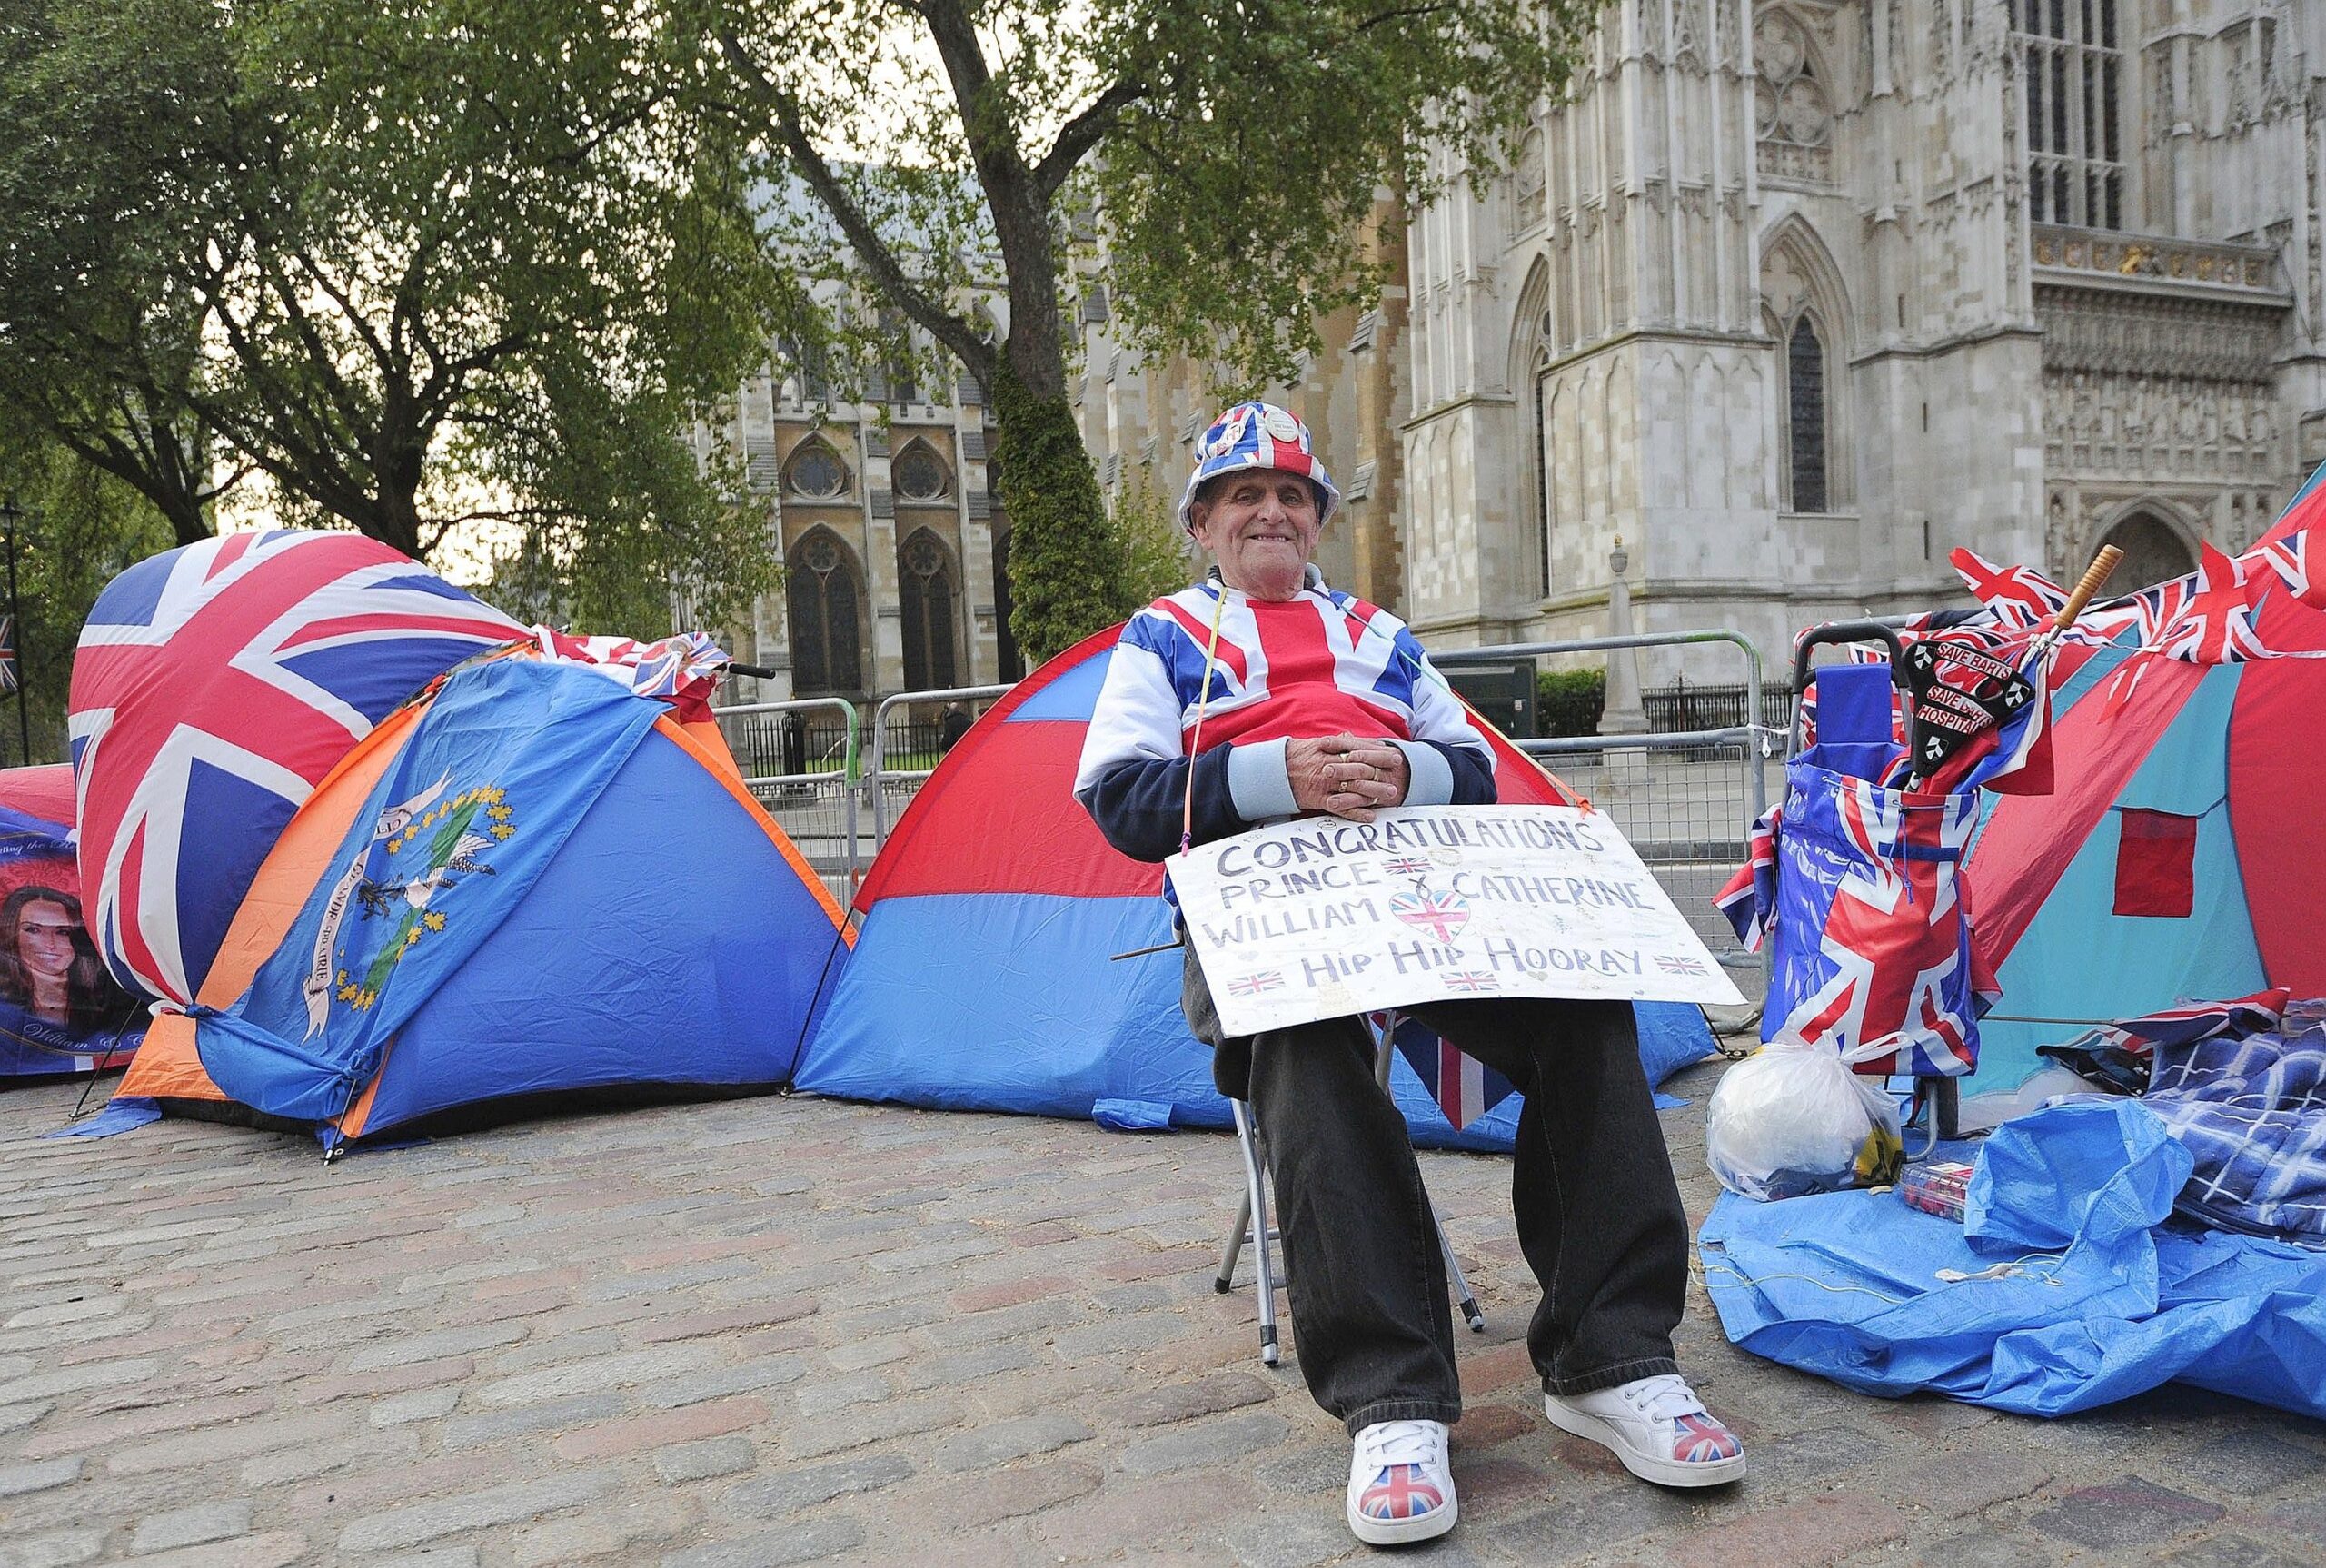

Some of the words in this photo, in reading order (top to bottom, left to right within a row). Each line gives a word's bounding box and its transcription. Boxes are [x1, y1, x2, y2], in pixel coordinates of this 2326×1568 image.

[1937, 643, 1969, 663] SAVE
[1970, 654, 2011, 680] BARTS
[1927, 686, 1960, 707] SAVE
[1216, 819, 1605, 878] CONGRATULATIONS
[1220, 860, 1382, 910] PRINCE
[1451, 871, 1656, 911] CATHERINE
[1200, 898, 1381, 948] WILLIAM
[1483, 937, 1643, 977] HOORAY
[23, 1022, 90, 1049] William
